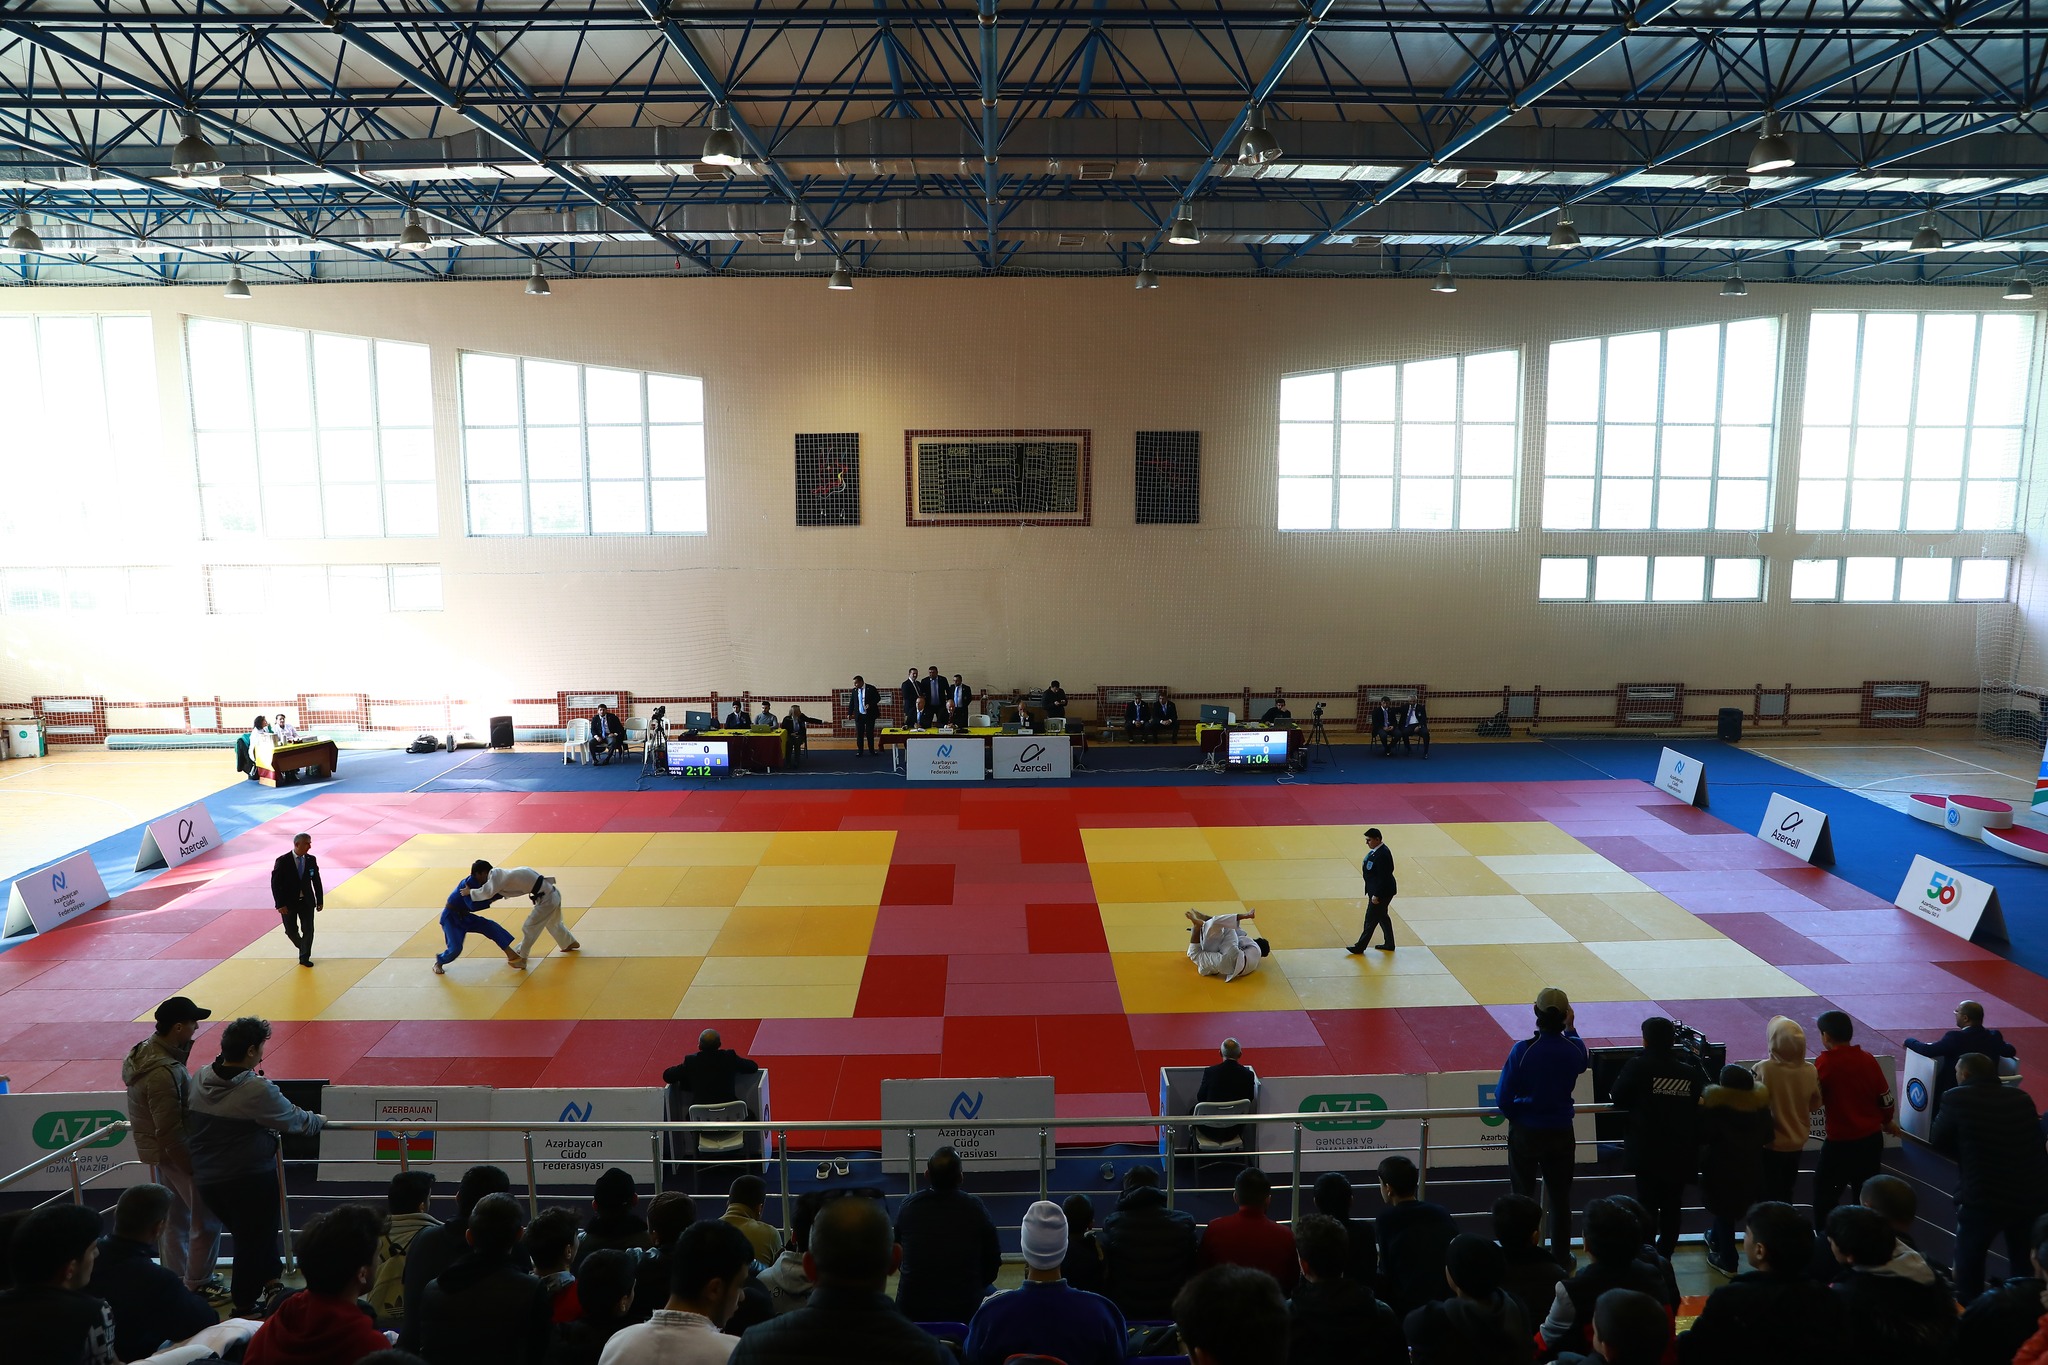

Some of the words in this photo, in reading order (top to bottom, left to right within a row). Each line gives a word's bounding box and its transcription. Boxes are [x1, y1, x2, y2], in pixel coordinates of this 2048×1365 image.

[1264, 735, 1269, 743] 0
[704, 746, 709, 754] 0
[1263, 746, 1269, 754] 0
[704, 757, 710, 766] 0
[1246, 754, 1269, 764] 1:04
[686, 766, 711, 776] 2:12
[1013, 763, 1052, 772] Azercell
[1771, 829, 1800, 849] Azercell
[179, 836, 208, 858] Azercell
[382, 1105, 433, 1114] AZERBAIJAN
[48, 1117, 112, 1142] AZE
[938, 1128, 995, 1139] Azərbaycan
[545, 1139, 603, 1150] Azərbaycan
[953, 1138, 980, 1148] Cüdo
[1315, 1138, 1359, 1146] GƏNCLƏR
[95, 1155, 109, 1163] VƏ
[560, 1149, 587, 1159] Cüdo
